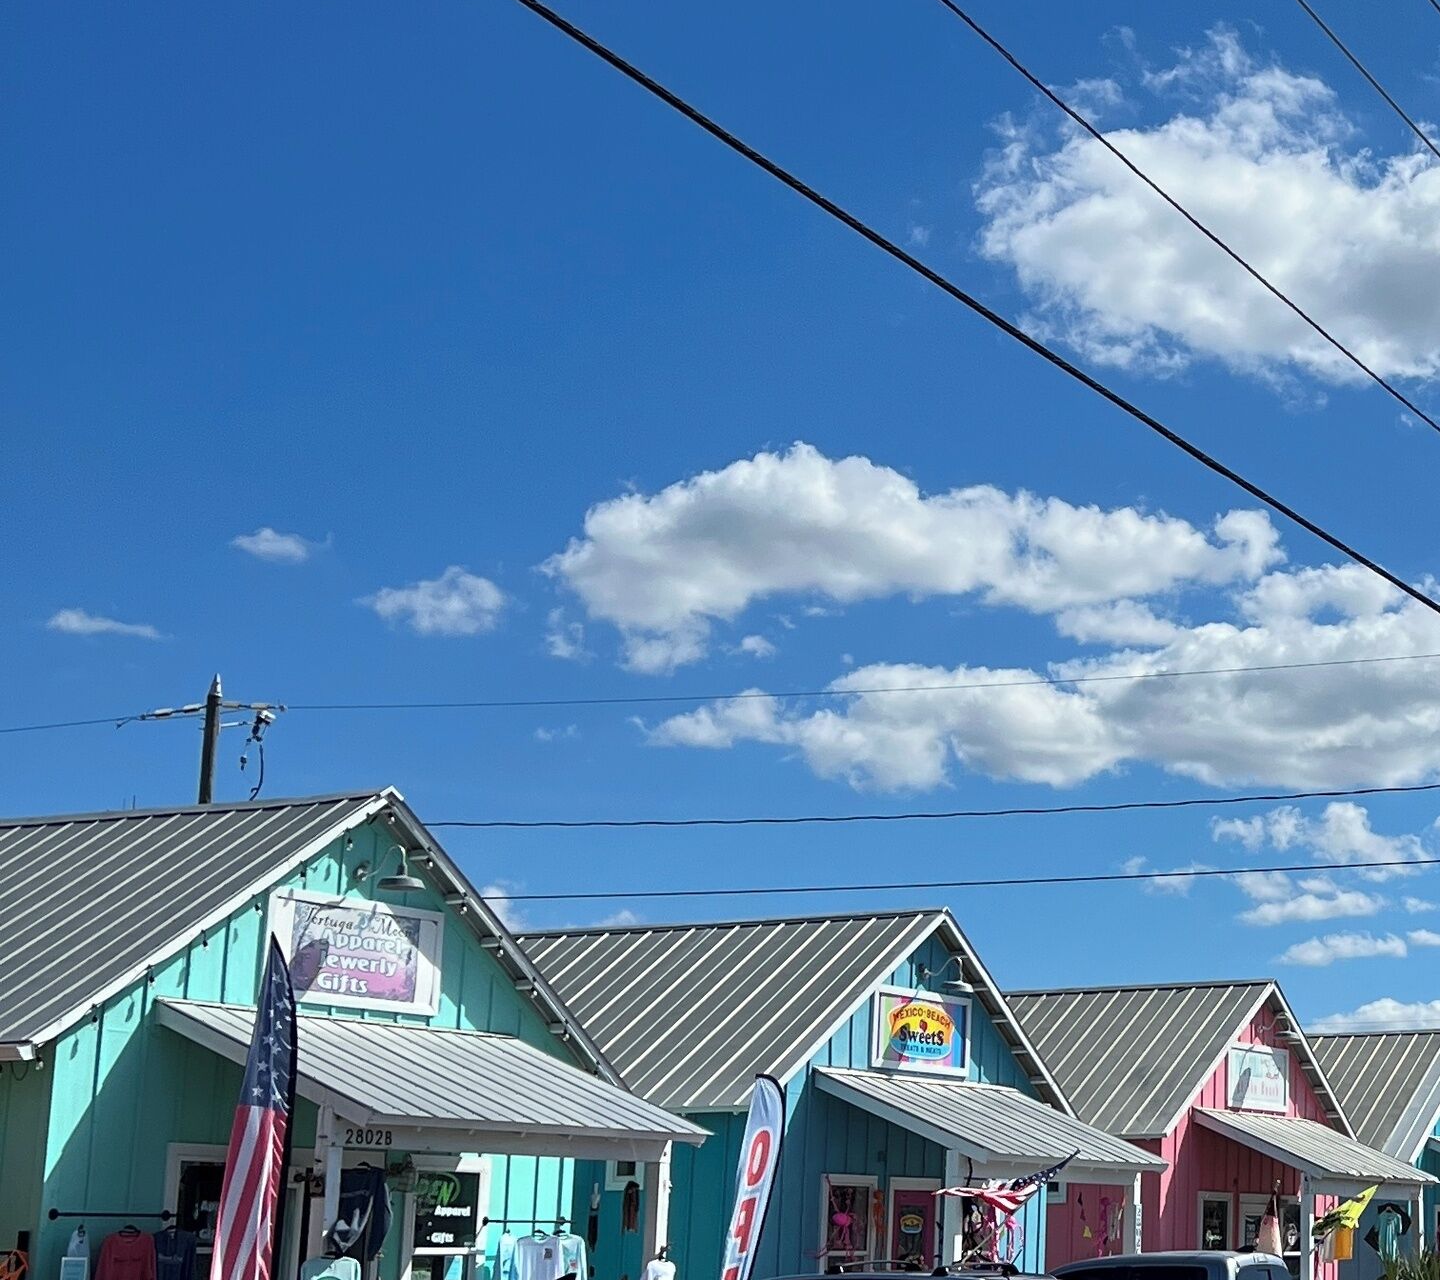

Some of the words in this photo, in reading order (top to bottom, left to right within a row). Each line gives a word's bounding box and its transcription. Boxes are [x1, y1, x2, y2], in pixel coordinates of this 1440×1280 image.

[305, 906, 354, 933] Tortuga
[322, 928, 408, 955] Apparel
[318, 952, 398, 976] Jewerly
[316, 972, 368, 993] Gifts
[893, 1008, 923, 1021] MEXICO
[926, 1009, 951, 1029] BEACH
[434, 1205, 471, 1217] Apparel
[431, 1232, 454, 1243] Gifts
